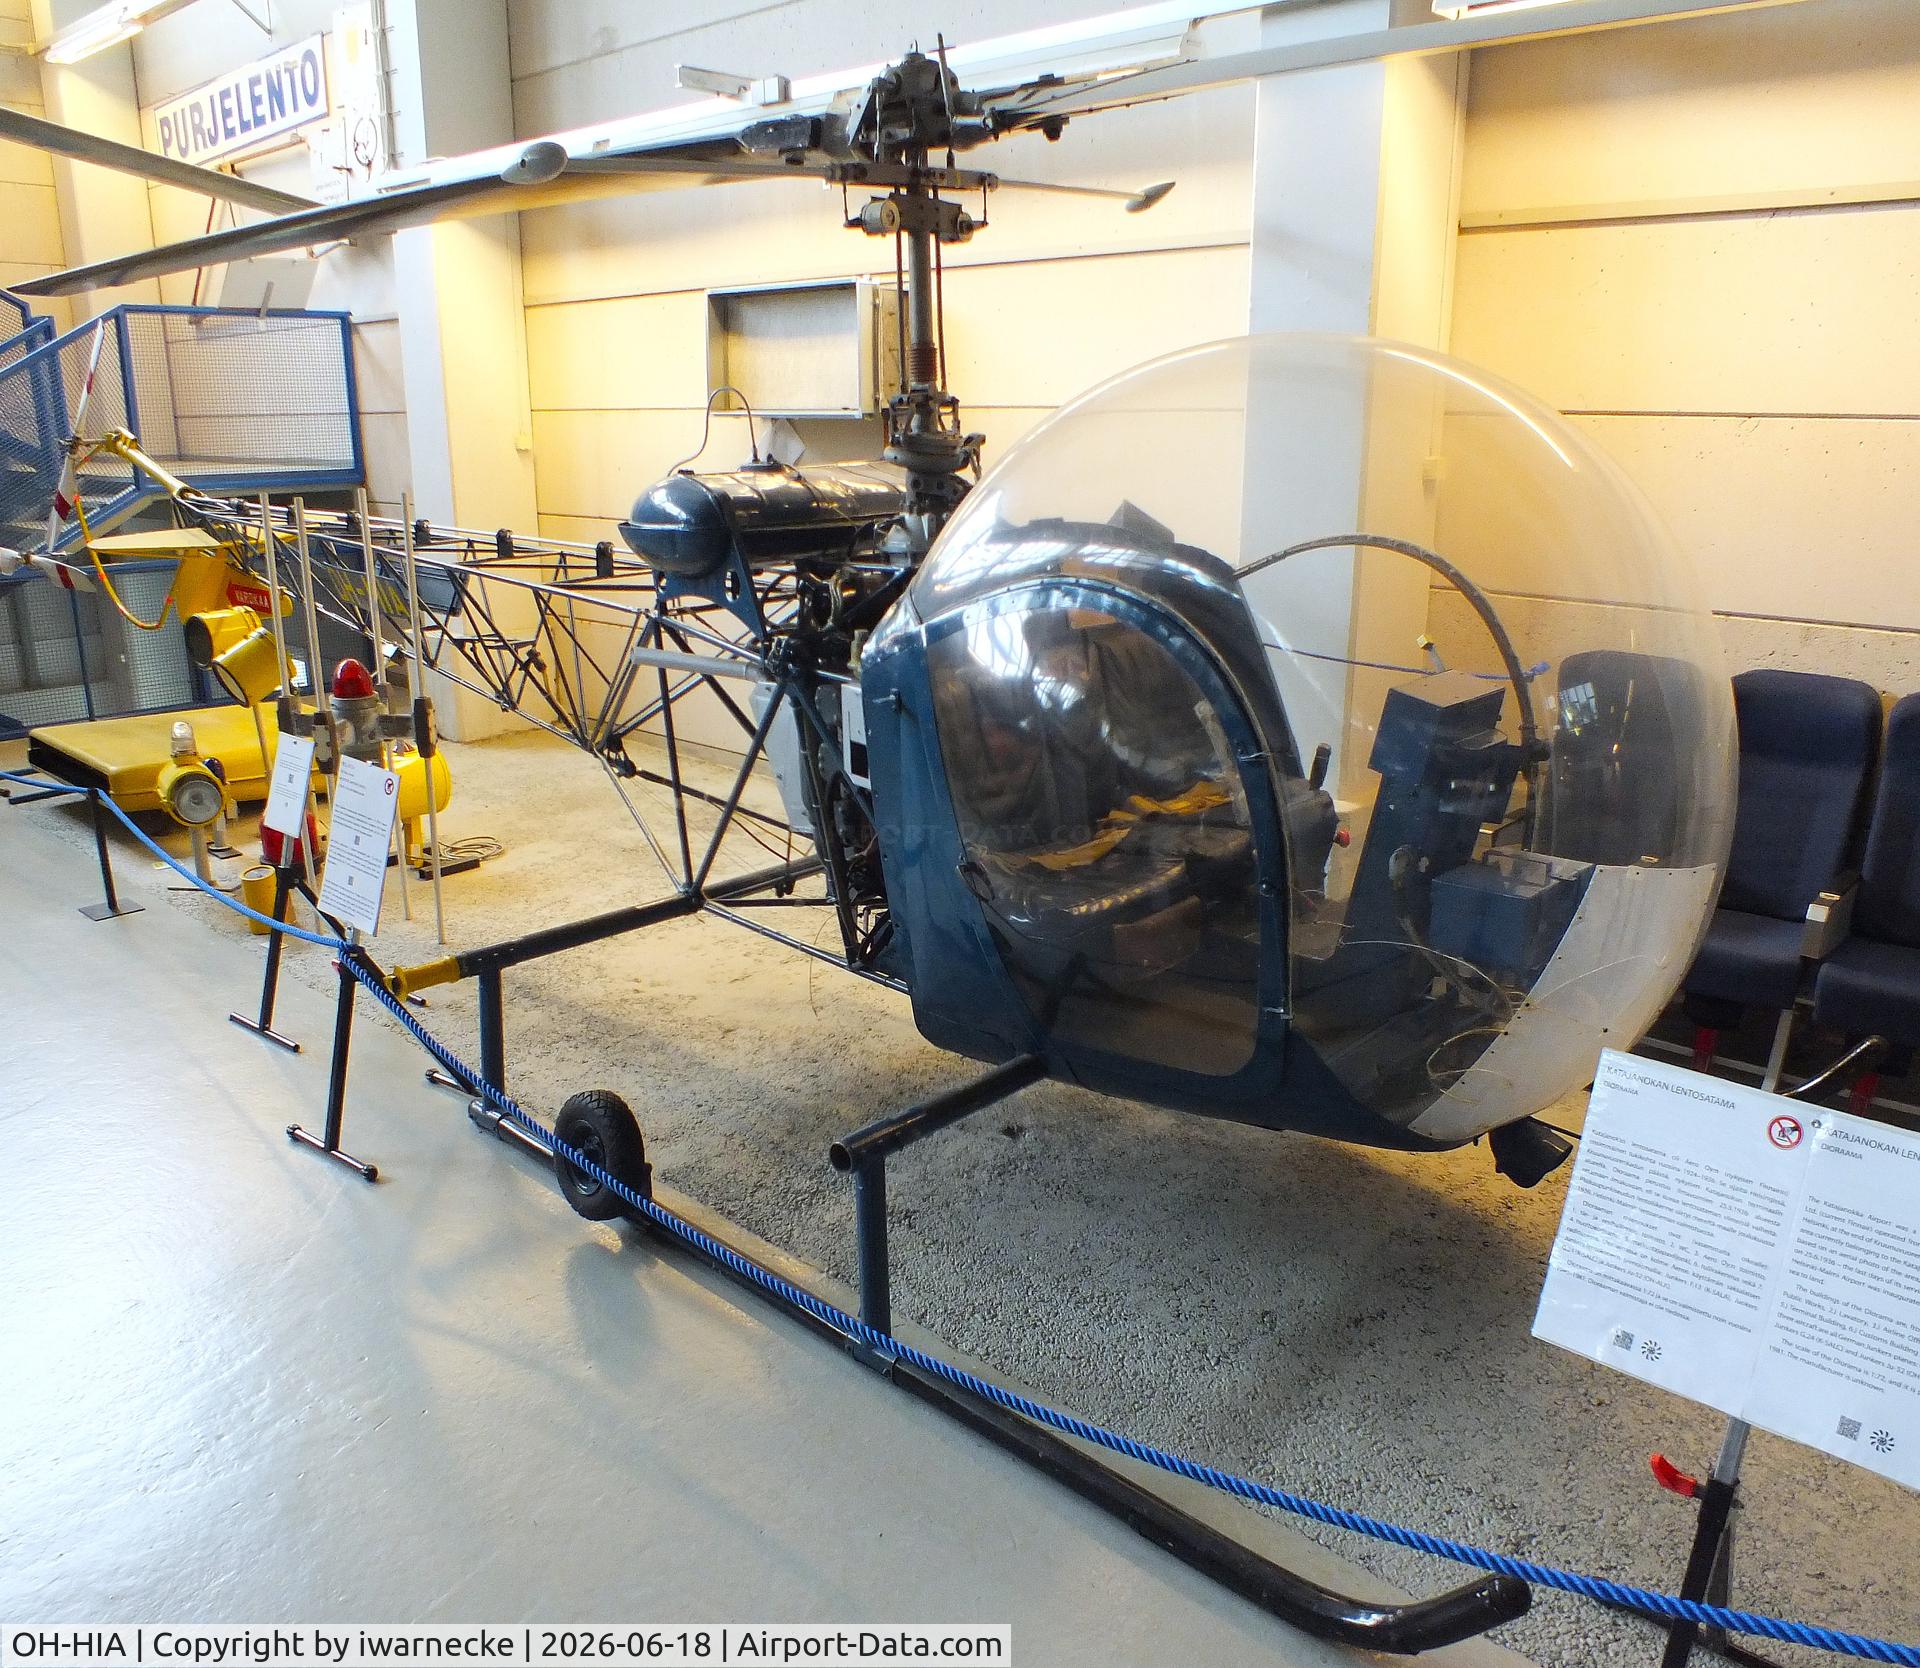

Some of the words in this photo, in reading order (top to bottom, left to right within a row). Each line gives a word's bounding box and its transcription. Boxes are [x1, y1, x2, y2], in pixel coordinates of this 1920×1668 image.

[159, 48, 320, 158] PURJELENTO
[1606, 1065, 1668, 1090] KATAJANOKAN
[1670, 1084, 1735, 1110] LENTOSATAMA
[1820, 1141, 1862, 1161] DIORAAMA
